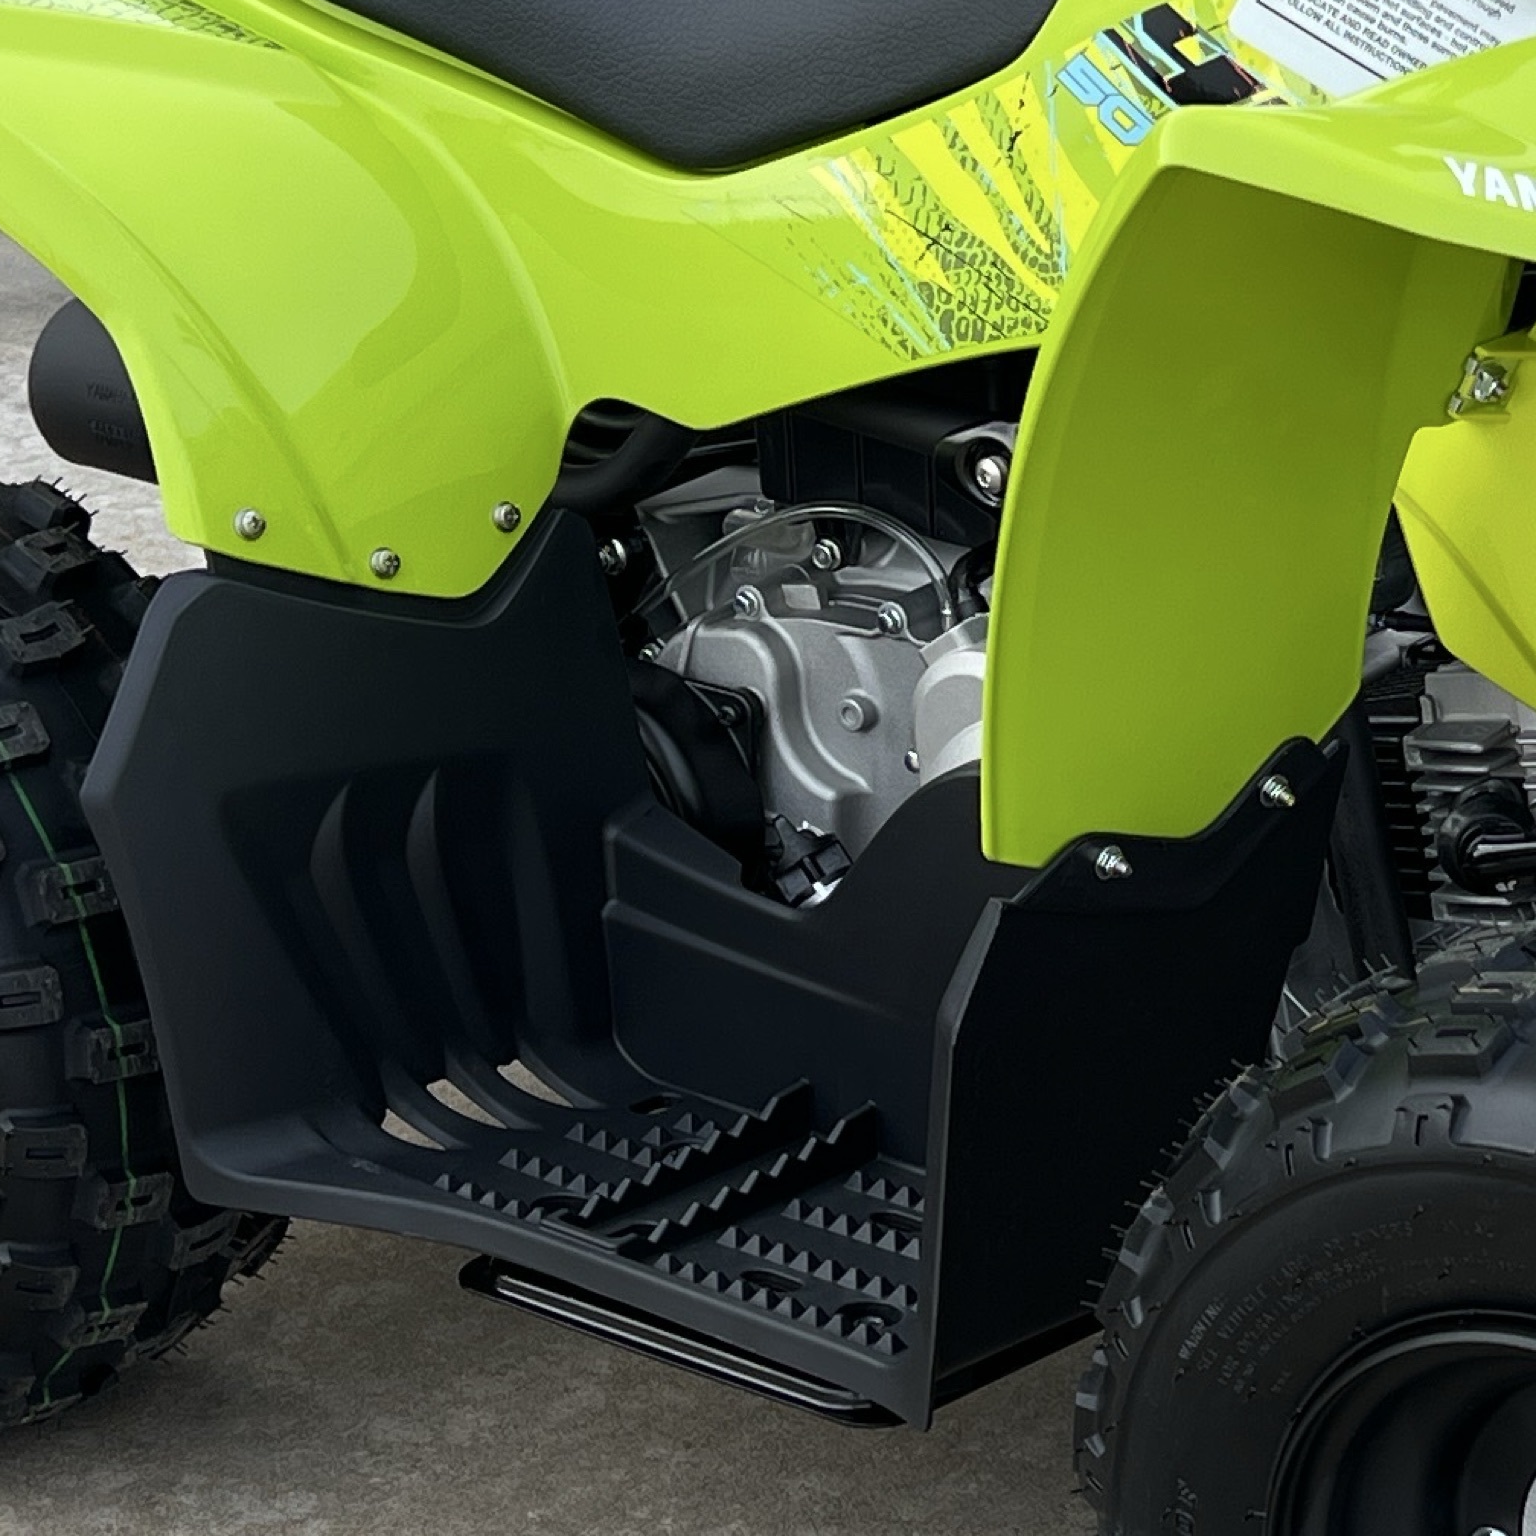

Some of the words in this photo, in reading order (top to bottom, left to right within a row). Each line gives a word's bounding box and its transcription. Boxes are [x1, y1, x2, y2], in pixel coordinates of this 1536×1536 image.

[1337, 11, 1363, 33] AND
[1360, 25, 1392, 50] READ
[1344, 1, 1378, 27] cause
[1379, 8, 1403, 28] and
[1400, 20, 1431, 45] those
[1398, 5, 1444, 40] surfaces
[1448, 36, 1469, 55] hot
[1431, 12, 1455, 33] and
